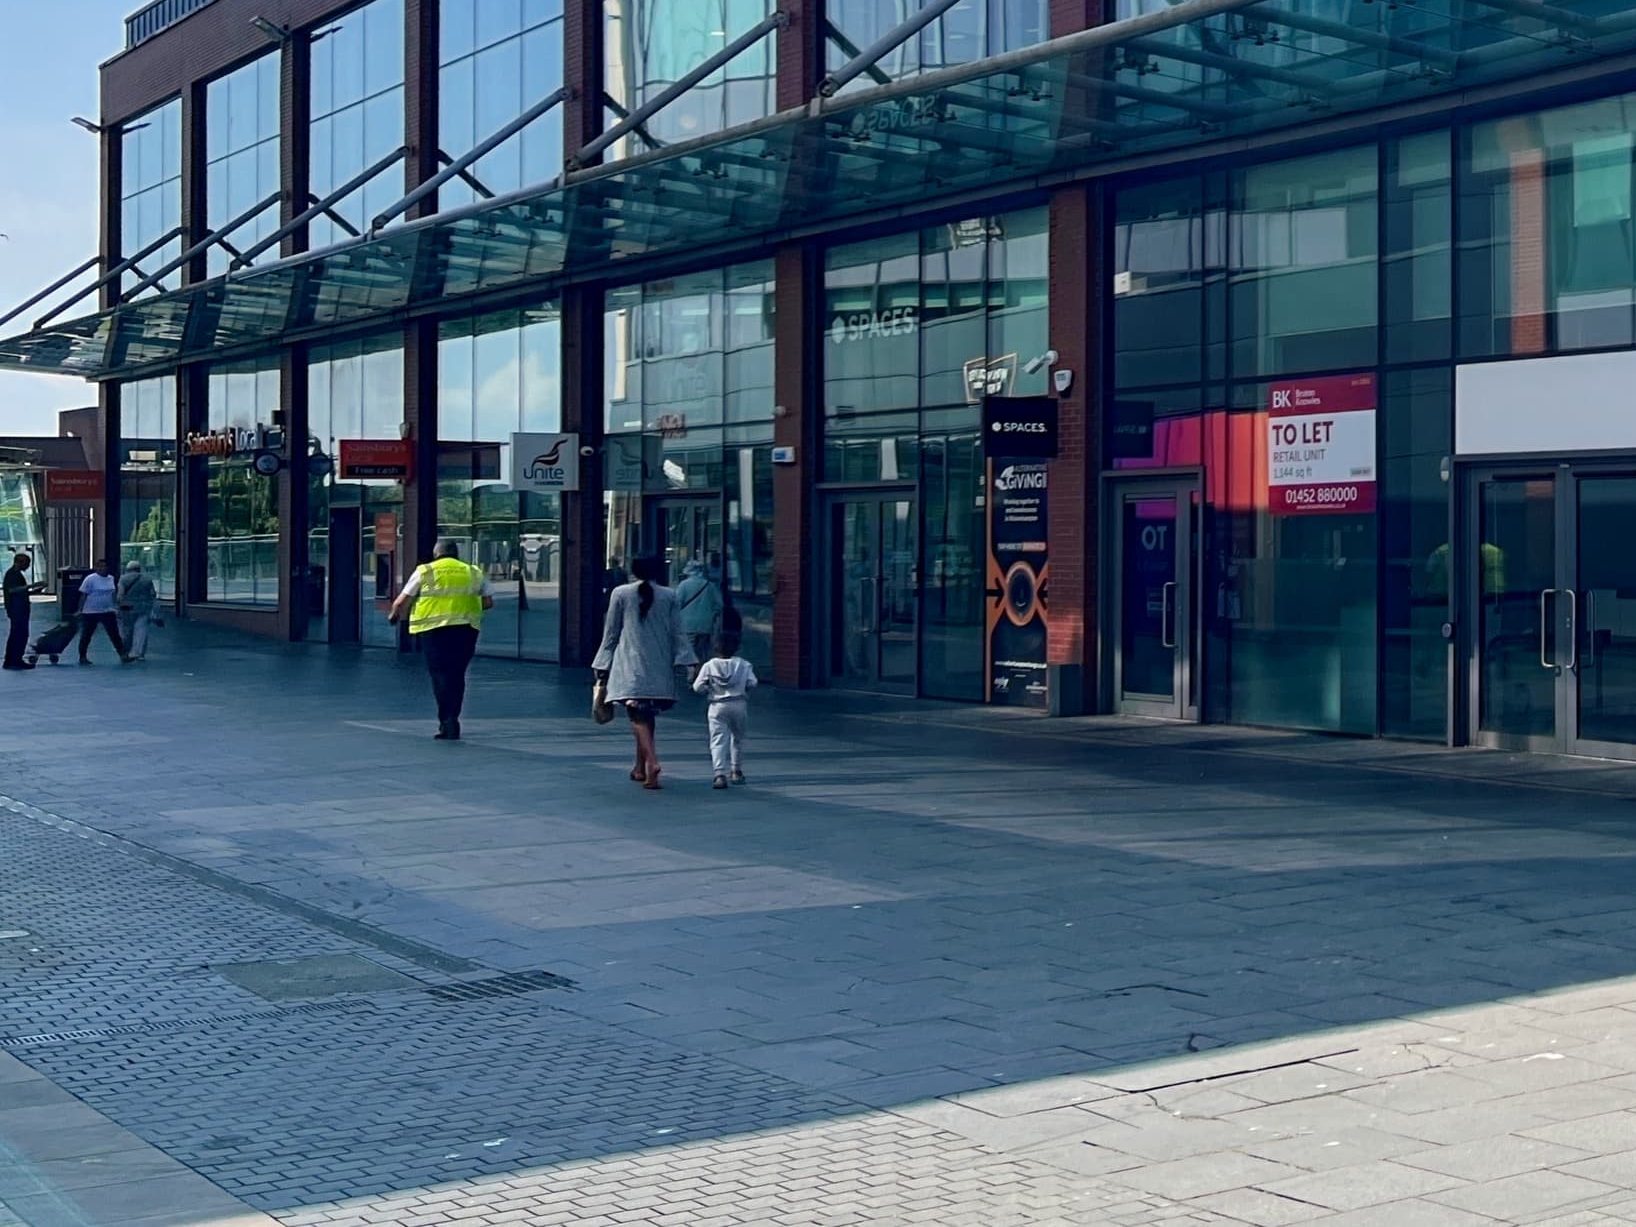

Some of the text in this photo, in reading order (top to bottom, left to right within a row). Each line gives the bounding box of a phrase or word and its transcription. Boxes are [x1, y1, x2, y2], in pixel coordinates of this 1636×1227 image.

[849, 308, 919, 341] SPACES.
[1272, 390, 1292, 409] BK
[1003, 422, 1048, 433] SPACES.
[1272, 421, 1334, 446] TO LET
[1273, 448, 1326, 464] RETAIL UNIT
[1295, 469, 1305, 479] sq
[1306, 466, 1313, 477] ft
[1285, 486, 1358, 504] 01452 880000
